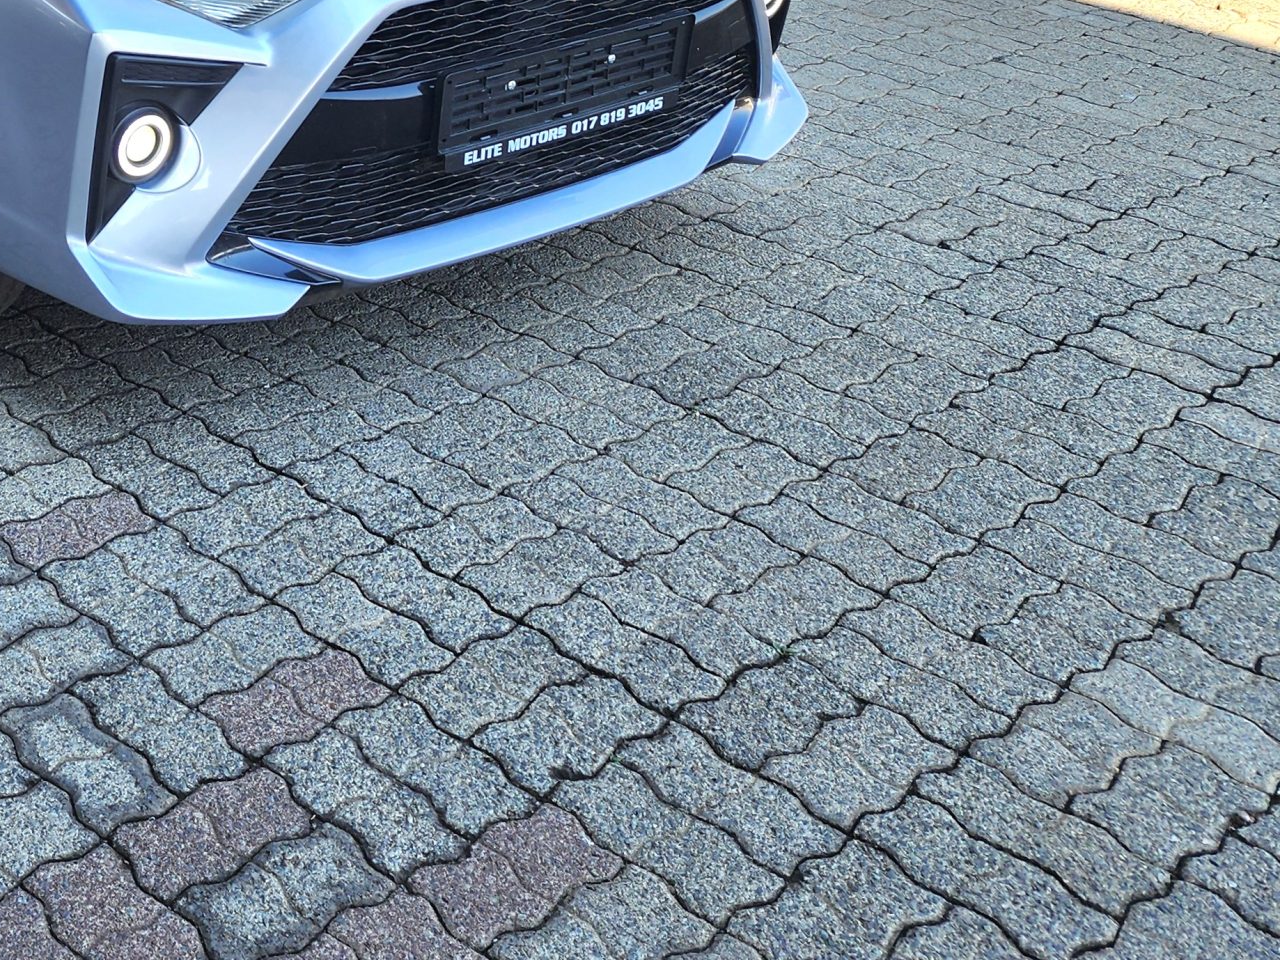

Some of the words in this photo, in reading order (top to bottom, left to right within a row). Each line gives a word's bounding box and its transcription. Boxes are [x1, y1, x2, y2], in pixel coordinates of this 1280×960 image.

[463, 143, 504, 166] ELITE
[507, 125, 568, 154] MOTORS
[571, 117, 598, 136] 017
[600, 107, 626, 126] 819
[628, 96, 664, 119] 3045
